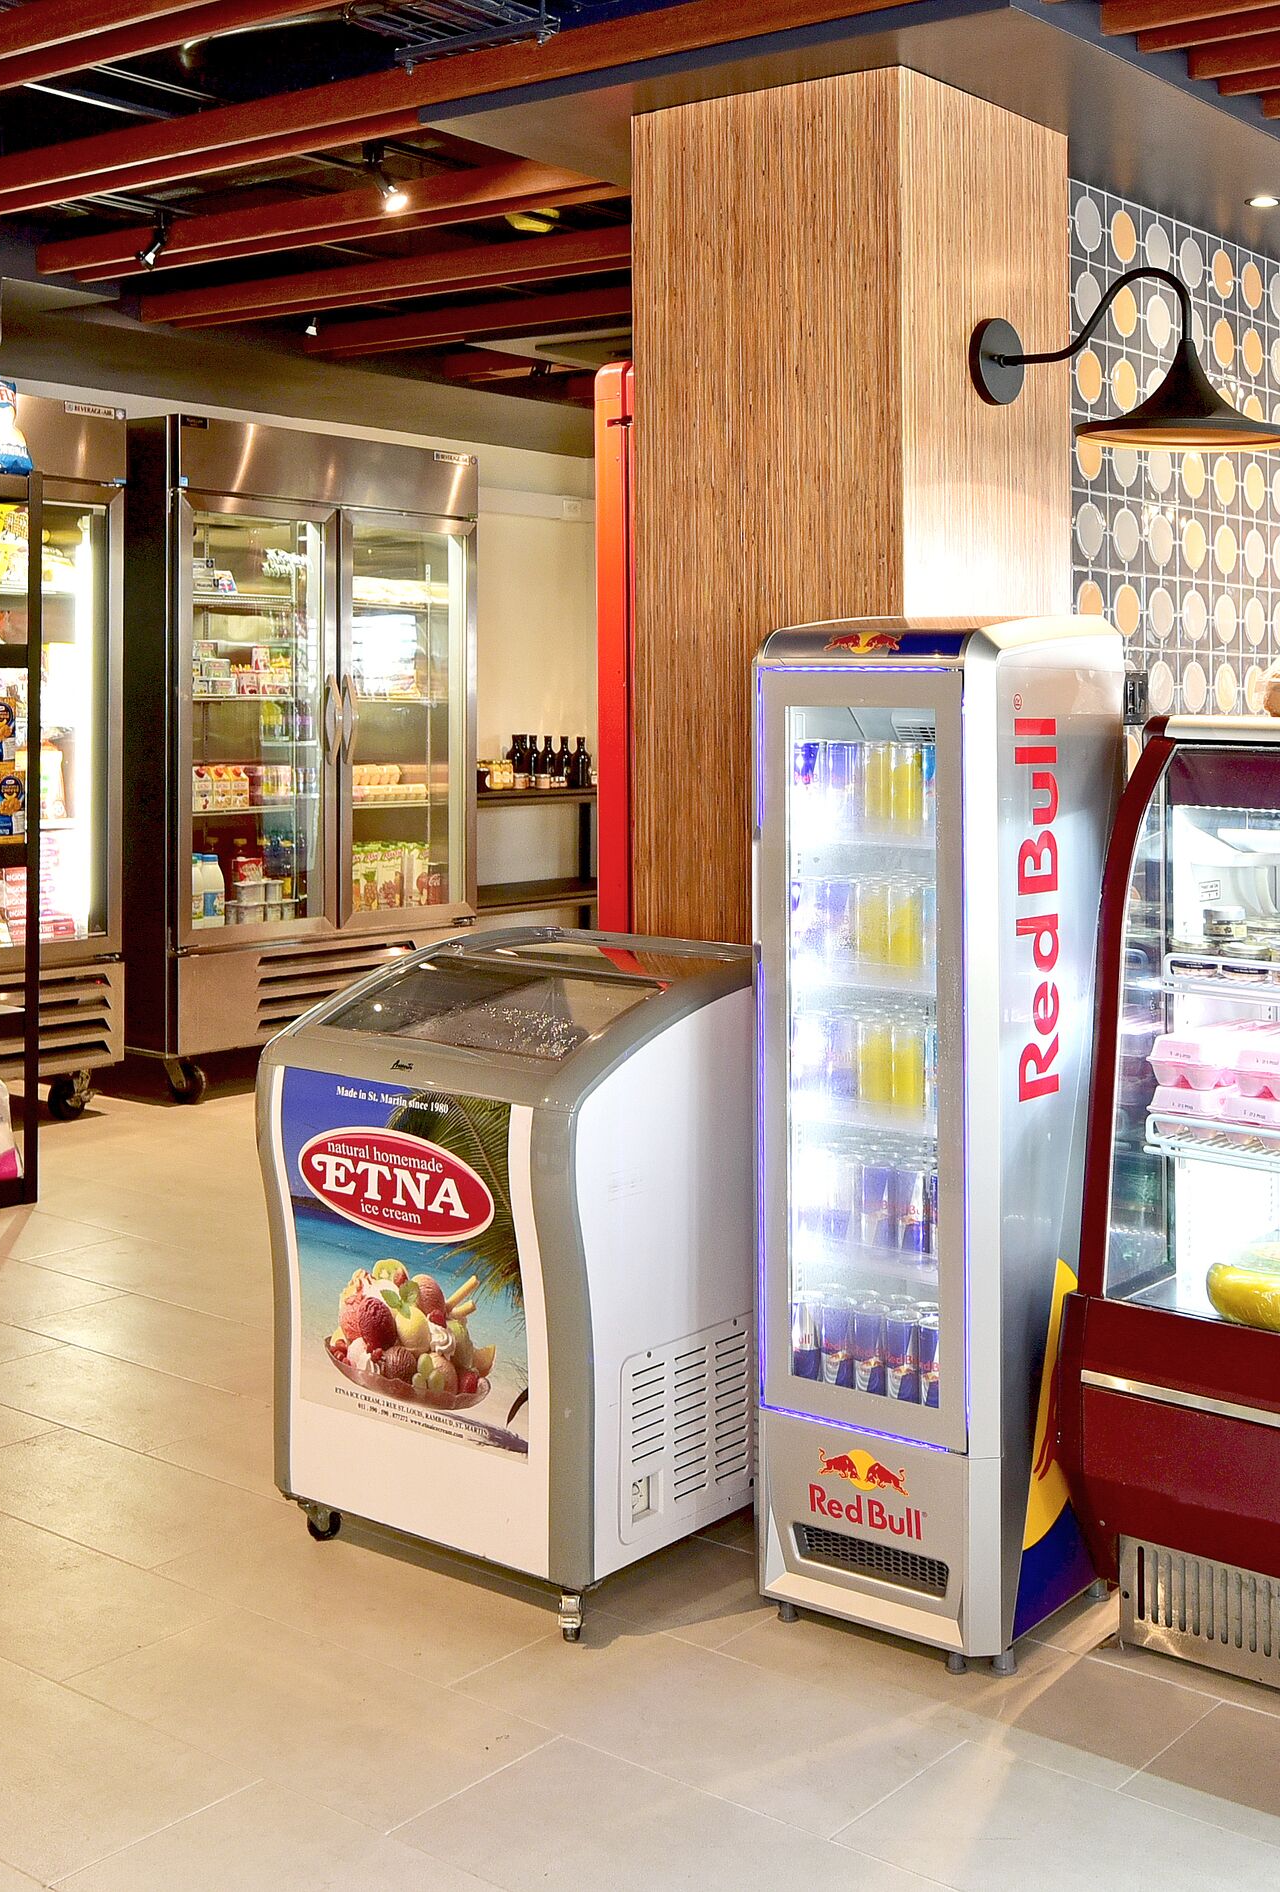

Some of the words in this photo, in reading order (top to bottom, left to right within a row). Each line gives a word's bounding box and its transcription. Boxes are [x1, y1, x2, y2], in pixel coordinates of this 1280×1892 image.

[1014, 718, 1058, 896] Bull
[1016, 913, 1060, 1102] Red
[336, 1086, 358, 1098] Made
[359, 1092, 366, 1100] in
[368, 1092, 379, 1102] St.
[380, 1094, 407, 1106] Martin
[409, 1099, 428, 1110] since
[430, 1102, 448, 1114] 1980
[327, 1141, 370, 1160] natural
[373, 1147, 443, 1174] homemade
[311, 1153, 469, 1219] ETNA
[361, 1199, 379, 1214] ice
[382, 1207, 421, 1224] cream
[335, 1387, 349, 1397] ETNA
[360, 1393, 381, 1405] CREAM,
[386, 1400, 397, 1409] RUE
[406, 1407, 424, 1418] LOUIS,
[425, 1413, 454, 1427] RAMBAUD,
[455, 1421, 464, 1430] ST.
[465, 1424, 489, 1437] MARTIN
[808, 1483, 861, 1525] Red
[867, 1495, 922, 1541] Bull
